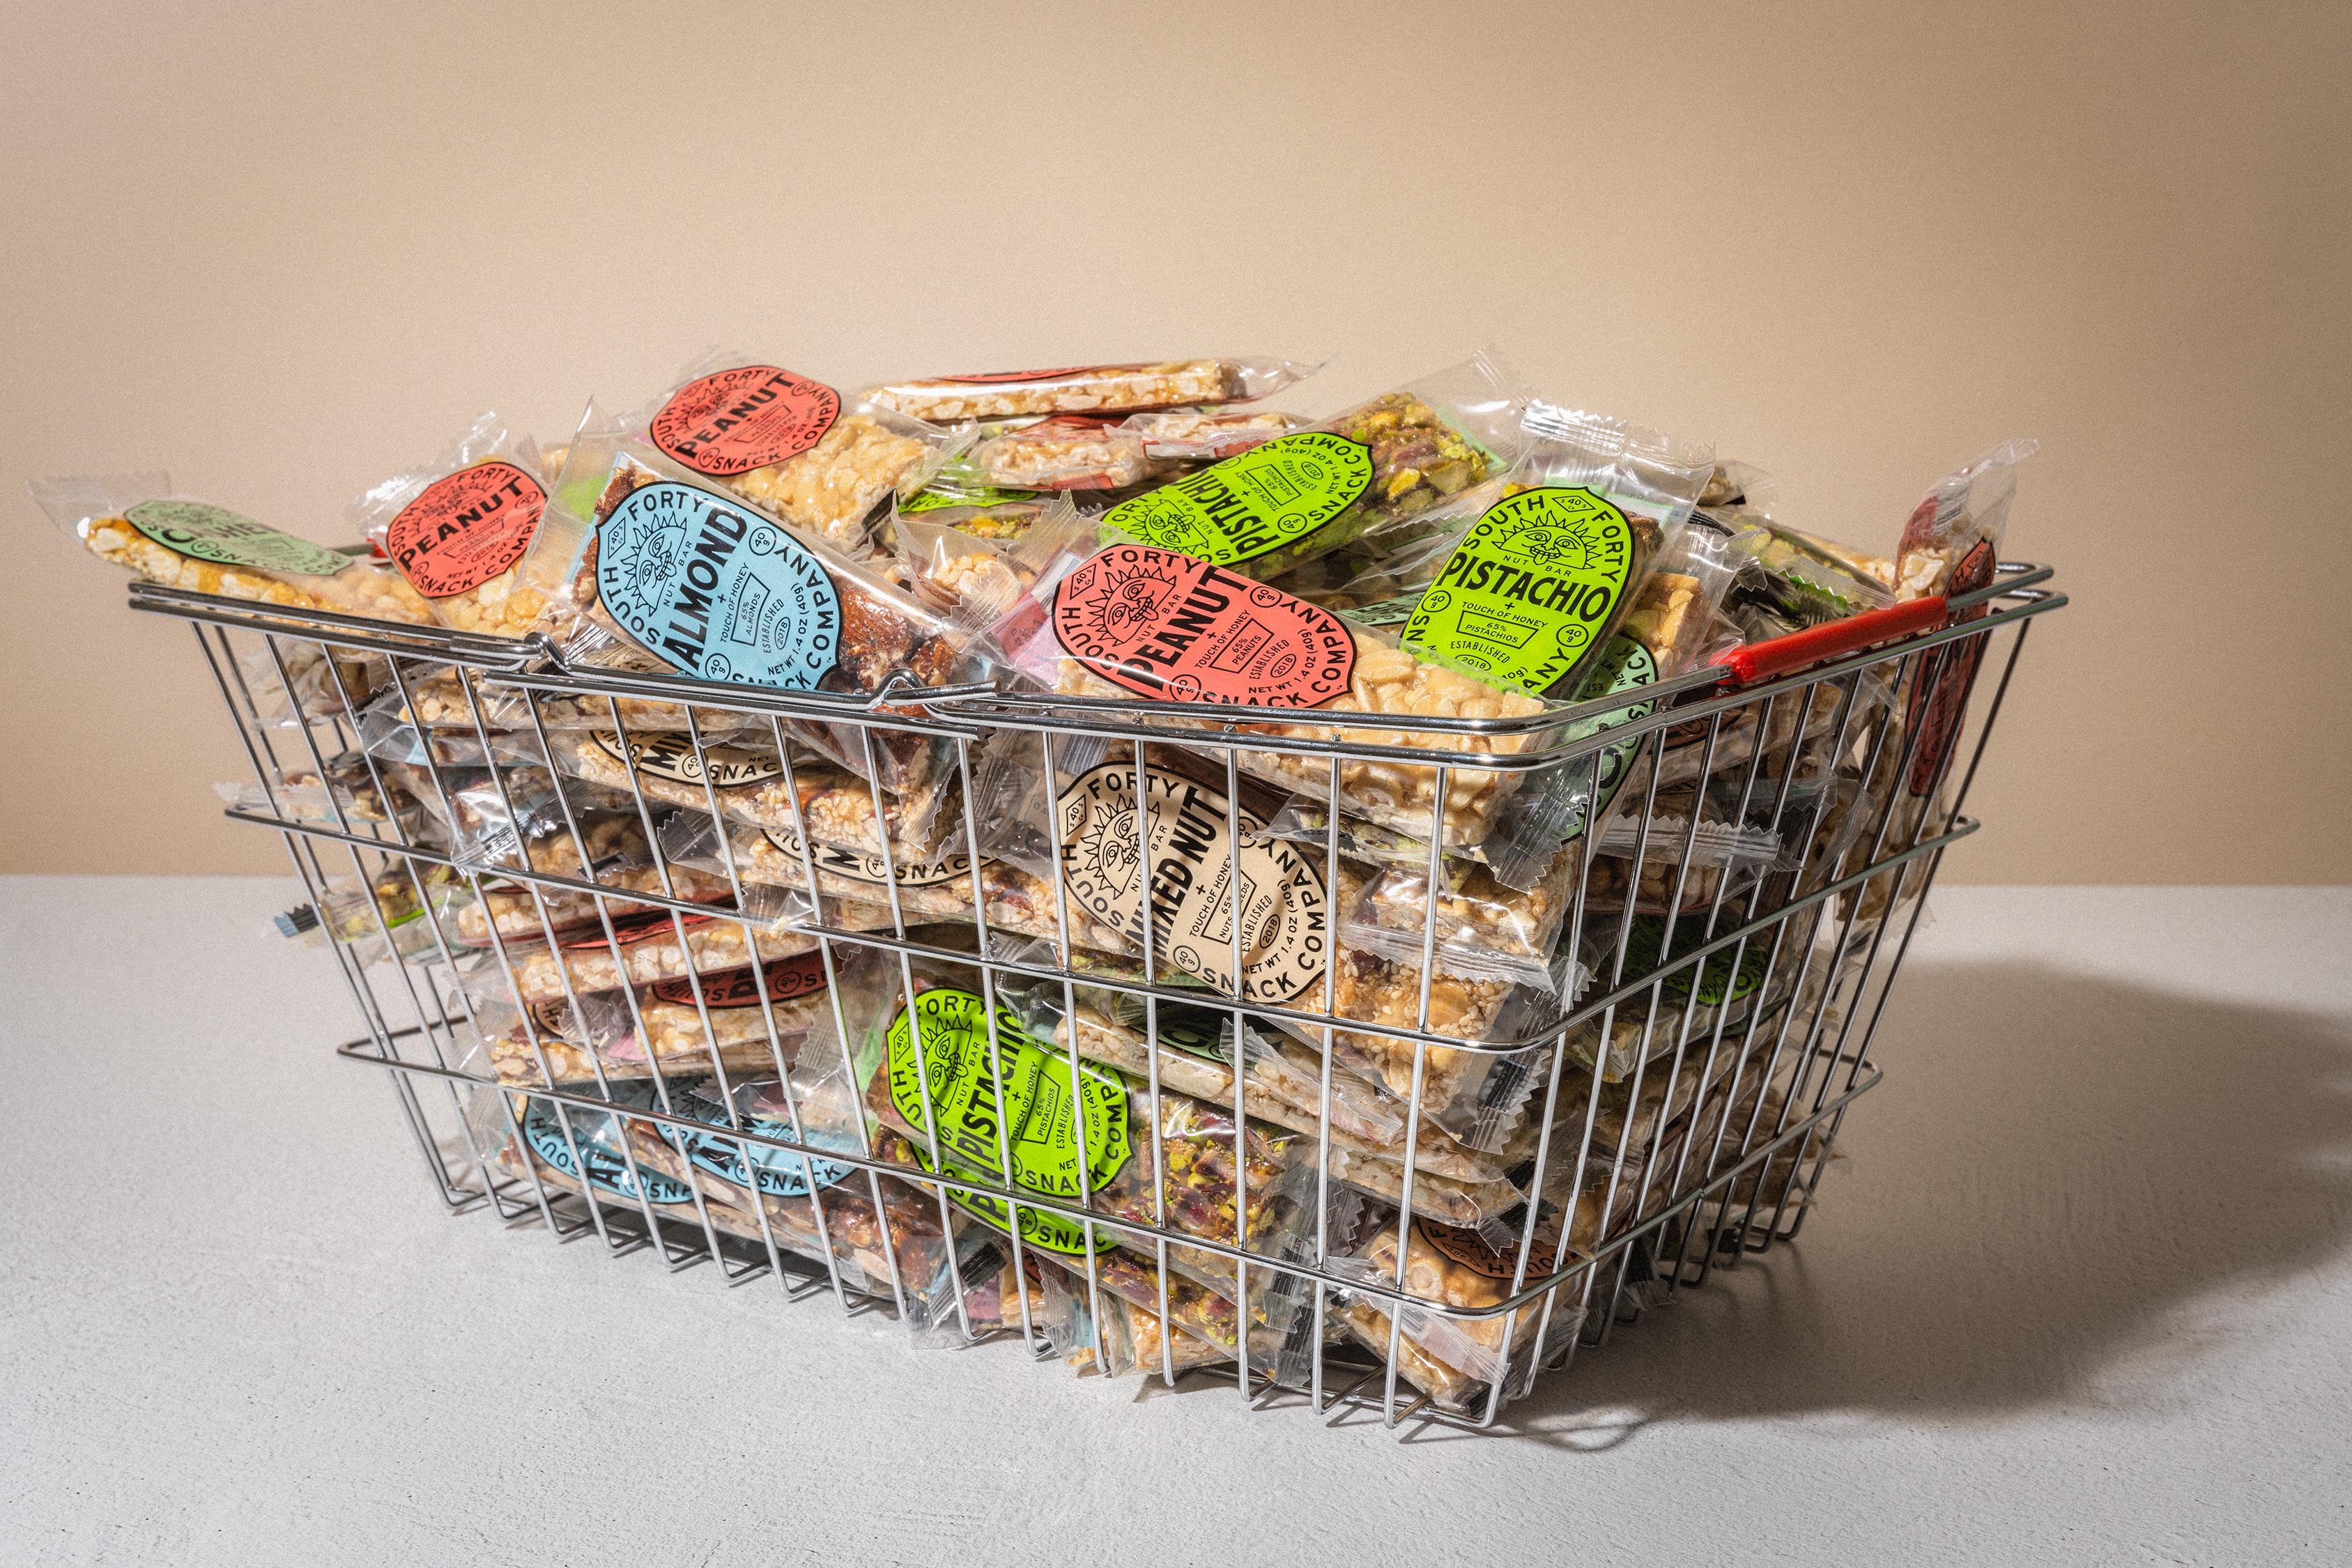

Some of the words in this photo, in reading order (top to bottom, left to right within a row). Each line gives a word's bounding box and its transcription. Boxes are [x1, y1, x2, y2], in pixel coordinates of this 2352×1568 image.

[657, 407, 680, 449] SOUTH
[709, 370, 776, 385] FORTY
[675, 373, 794, 459] PEANUT
[713, 453, 781, 470] SNACK
[792, 387, 833, 450] COMPANY
[1244, 436, 1362, 464] COMPANY
[1312, 452, 1326, 461] OZ
[1234, 472, 1254, 488] HONEY
[1264, 468, 1293, 496] PISTACHIOS
[1283, 460, 1318, 491] ESTABLISHED
[1304, 463, 1321, 477] 2018
[1332, 472, 1341, 481] WT
[1252, 485, 1261, 494] OF
[1266, 477, 1277, 490] 65%
[1308, 468, 1367, 521] SNACK
[1325, 482, 1339, 495] NET
[392, 507, 419, 556] SOUTH
[457, 468, 514, 482] FORTY
[627, 491, 709, 521] FORTY
[1178, 499, 1194, 512] BAR
[1261, 494, 1279, 512] TOUCH
[1567, 498, 1581, 507] 40
[399, 476, 523, 573] PEANUT
[1197, 520, 1214, 535] NUT
[1283, 520, 1295, 529] 40
[420, 575, 475, 592] SNACK
[485, 506, 541, 576] COMPAN
[612, 531, 620, 544] 40
[755, 532, 765, 547] 40
[1462, 495, 1545, 550] SOUTH
[1591, 509, 1624, 584] FORTY
[663, 581, 675, 606] NUT
[678, 541, 692, 567] BAR
[1502, 555, 1529, 566] NUT
[1545, 566, 1571, 577] BAR
[662, 507, 748, 671] ALMOND
[1076, 574, 1086, 585] 40
[1435, 551, 1611, 622] PISTACHIO
[604, 566, 661, 645] SOUTH
[721, 614, 733, 643] TOUCH
[728, 599, 736, 610] OF
[732, 562, 749, 597] HONEY
[774, 544, 833, 669] COMPANY
[791, 583, 809, 615] (40g)
[1257, 589, 1269, 601] 40
[741, 601, 749, 620] 65%
[746, 592, 761, 636] ALMONDS
[1062, 607, 1119, 670] SOUTH
[1100, 549, 1202, 574] FORTY
[1136, 624, 1155, 642] NUT
[1162, 594, 1182, 614] BAR
[1462, 601, 1496, 614] TOUCH
[1497, 610, 1511, 619] OF
[1512, 613, 1548, 628] HONEY
[762, 599, 784, 653] ESTABLISHED
[777, 621, 788, 645] 2018
[799, 619, 808, 634] OZ
[1116, 566, 1249, 692] PEANUT
[1465, 624, 1519, 644] PISTACHIOS
[1486, 622, 1507, 633] 65%
[1565, 629, 1582, 637] 40
[794, 638, 804, 655] 1.4
[1194, 645, 1218, 669] TOUCH
[1217, 634, 1228, 645] OF
[1227, 610, 1251, 634] HONEY
[1231, 638, 1248, 654] 65%
[1232, 635, 1261, 665] PEANUTS
[1279, 600, 1346, 693] COMPANY
[1298, 629, 1318, 654] (40g)
[1450, 640, 1512, 664] ESTABLISHED
[711, 659, 721, 675] 40
[767, 663, 784, 675] NET
[785, 654, 796, 668] WT
[1249, 639, 1290, 679] ESTABLISHED
[1274, 657, 1293, 675] 2018
[1307, 656, 1316, 668] OZ
[1276, 681, 1292, 691] WT
[1295, 670, 1310, 683] 1.4
[1615, 643, 1650, 720] SACK
[709, 762, 778, 781] SNAC
[1086, 771, 1181, 800] FORTY
[1070, 808, 1079, 821] 40
[1151, 826, 1167, 851] BAR
[1125, 858, 1194, 957] MIXED
[1167, 787, 1227, 866] NUT
[1061, 844, 1125, 927] SOUTH
[1189, 905, 1210, 938] TOUCH
[1206, 889, 1217, 903] OF
[1214, 854, 1231, 889] HONEY
[1277, 879, 1298, 913] (40g)
[1203, 967, 1297, 998] SNACK
[1258, 838, 1325, 971] COMPANY
[1242, 895, 1272, 953] ESTABLISHED
[1263, 919, 1277, 942] 2018
[1289, 917, 1298, 932] OZ
[1281, 936, 1295, 953] 1.4
[1178, 951, 1188, 964] 40
[1243, 964, 1263, 974] NET
[1265, 953, 1281, 968] WT
[897, 1036, 904, 1049] 40
[957, 1082, 969, 1106] NUT
[969, 1043, 980, 1066] BAR
[956, 1012, 1026, 1165] PISTACHIO
[892, 1070, 953, 1141] SUTH
[1010, 1112, 1027, 1142] TOUCH
[1022, 1095, 1031, 1108] OF
[1027, 1061, 1038, 1094] HONEY
[1036, 1098, 1045, 1116] 65%
[1038, 1088, 1055, 1137] PISTACHIOS
[530, 1117, 579, 1175] SOUTH
[1059, 1158, 1077, 1171] NET
[1091, 1112, 1100, 1127] OZ
[758, 1165, 841, 1190] SNAK
